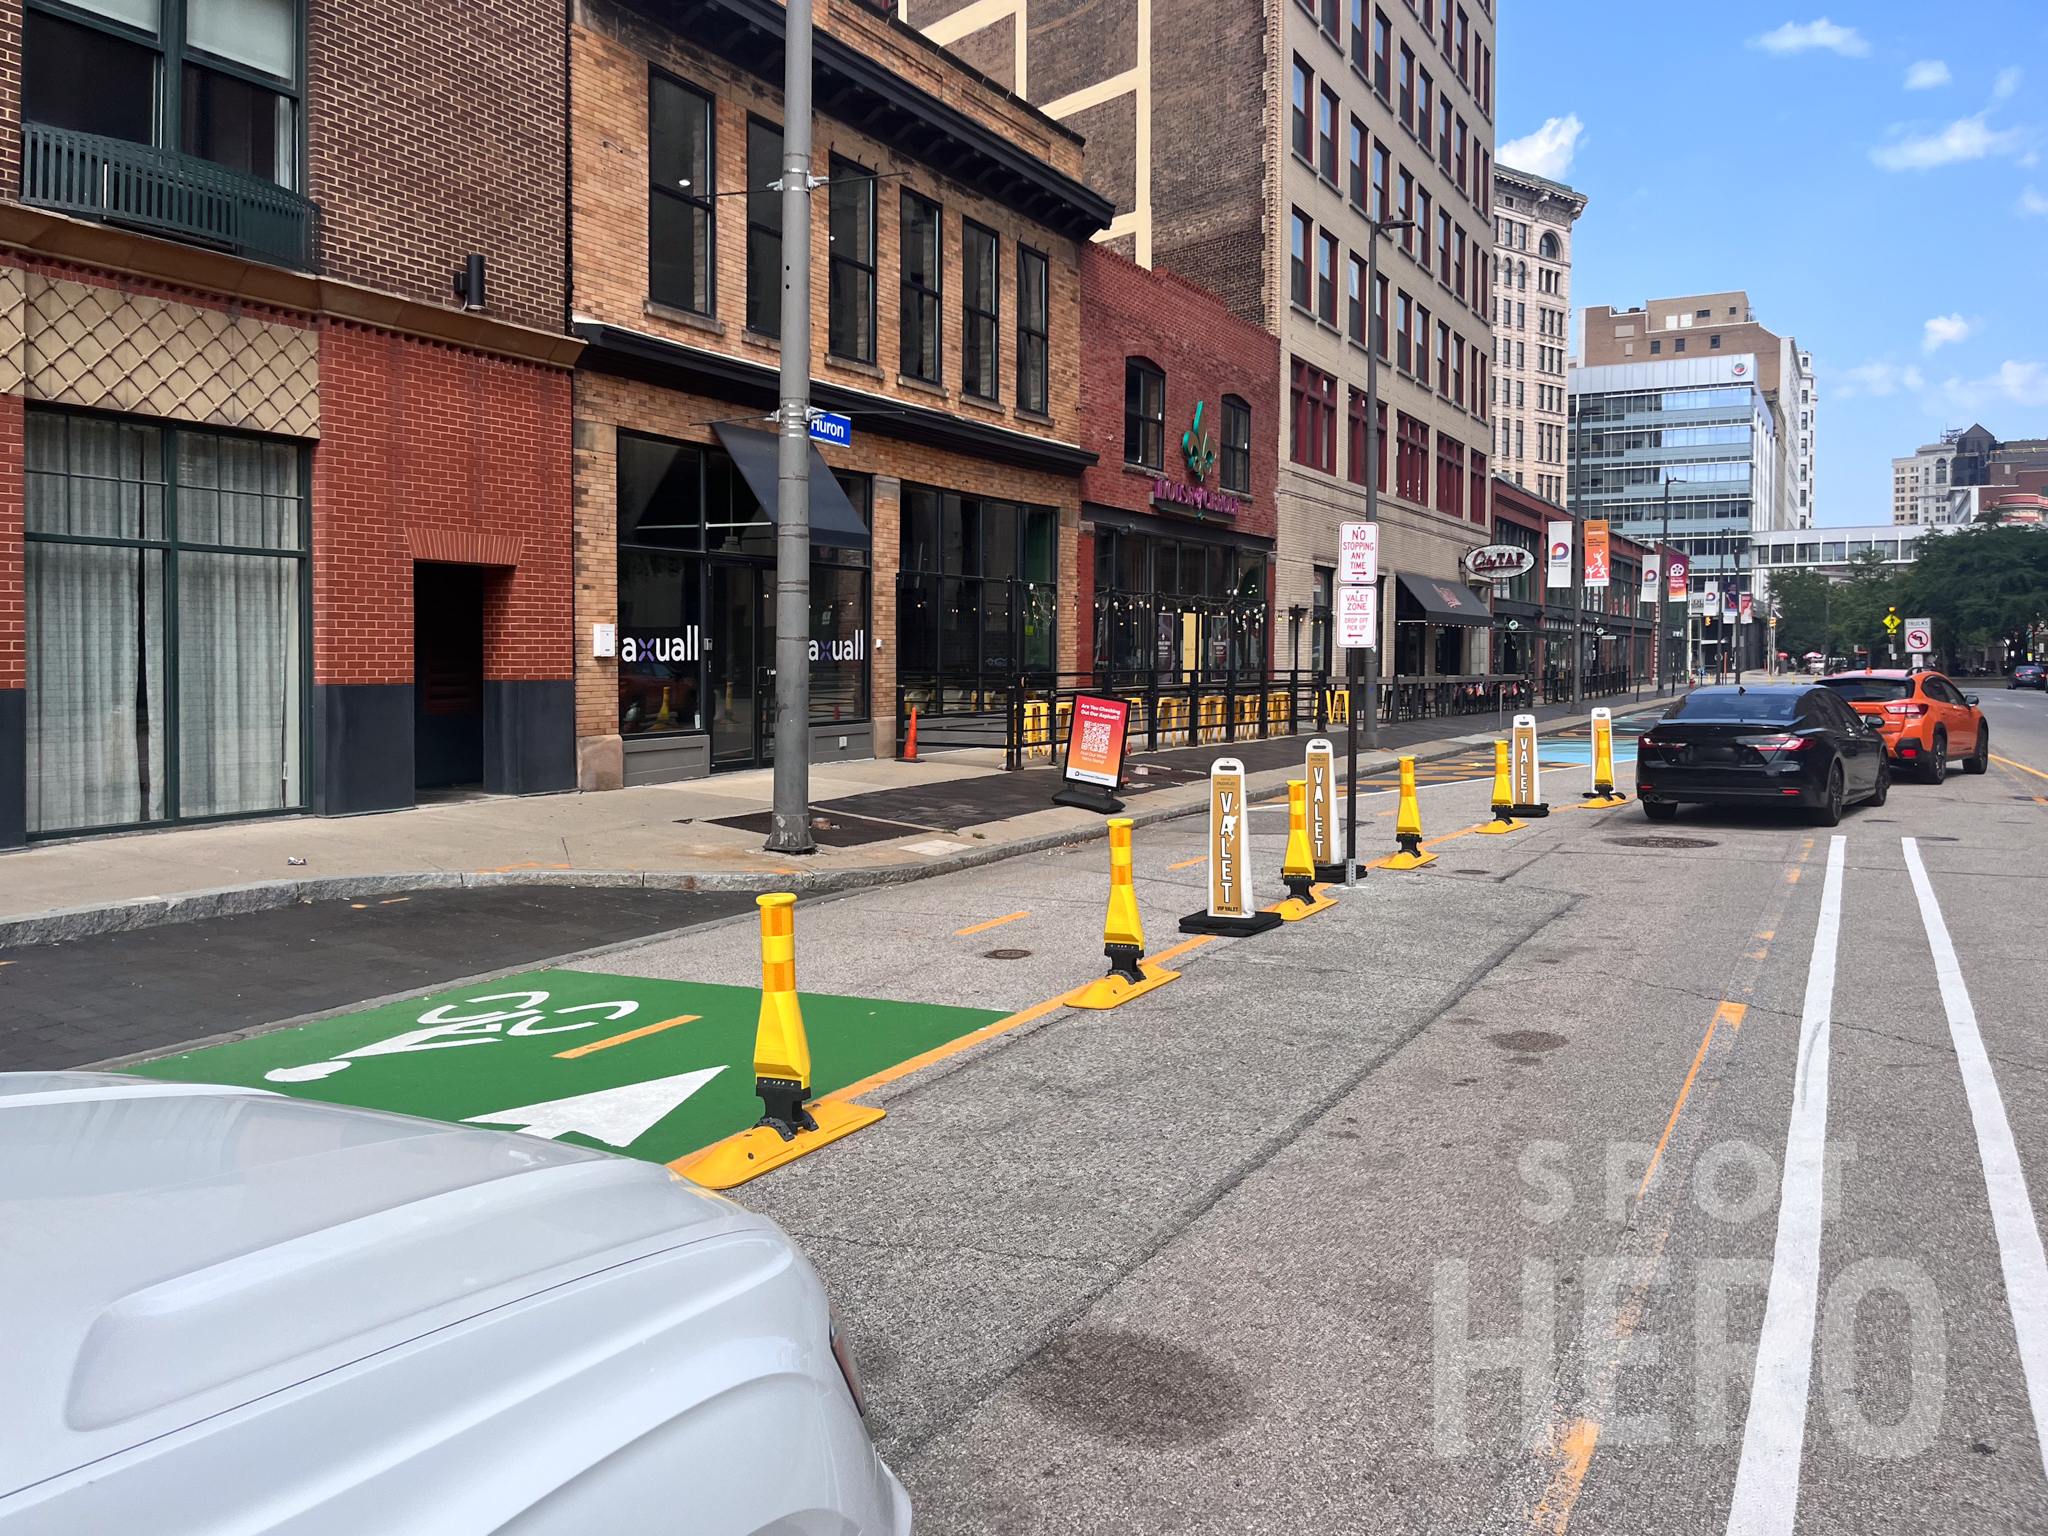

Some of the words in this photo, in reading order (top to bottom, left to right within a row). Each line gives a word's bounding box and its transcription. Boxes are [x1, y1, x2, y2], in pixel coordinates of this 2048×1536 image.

[811, 418, 844, 438] Huron
[1352, 530, 1366, 540] NO
[1343, 542, 1374, 551] STOPPING
[1351, 552, 1365, 560] ANY
[1346, 594, 1369, 602] VALET
[621, 625, 699, 662] axuall
[808, 630, 864, 661] axuall
[1099, 706, 1121, 715] Checking
[1520, 737, 1528, 803] VALET
[1313, 767, 1324, 858] VALET
[1220, 791, 1233, 903] VALET
